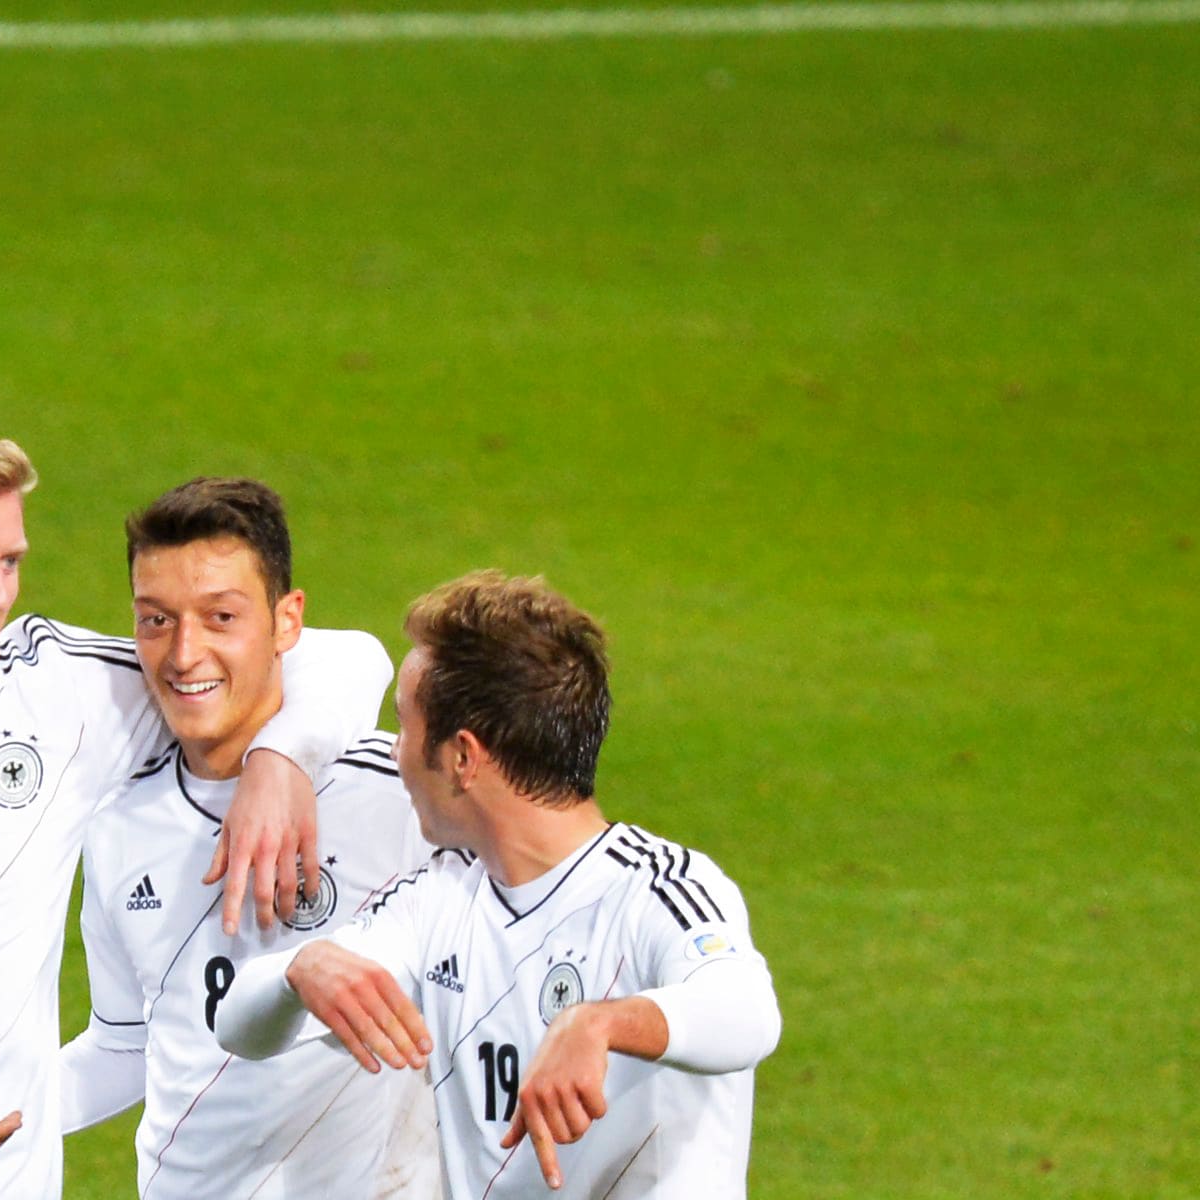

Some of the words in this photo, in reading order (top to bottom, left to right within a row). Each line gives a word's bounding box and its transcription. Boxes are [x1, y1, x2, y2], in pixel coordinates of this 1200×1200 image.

[126, 896, 161, 910] adidas
[426, 970, 463, 993] adidas
[478, 1041, 519, 1121] 19
